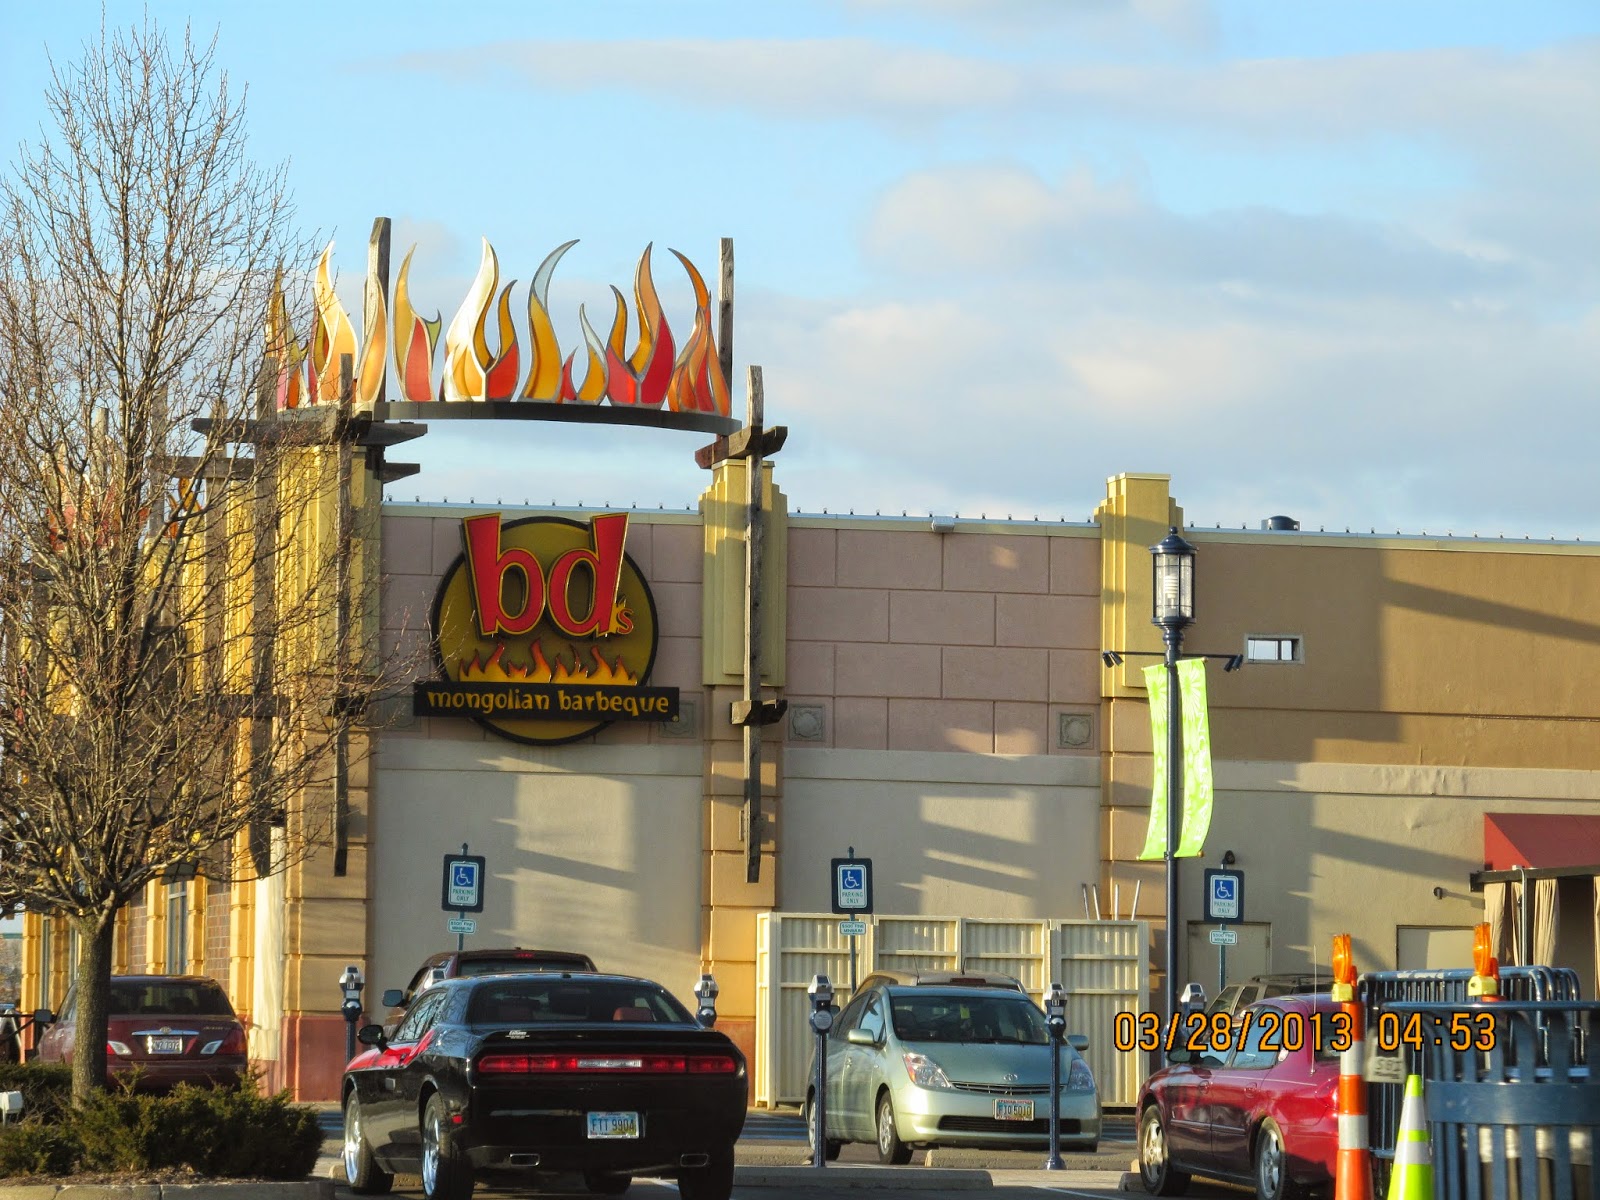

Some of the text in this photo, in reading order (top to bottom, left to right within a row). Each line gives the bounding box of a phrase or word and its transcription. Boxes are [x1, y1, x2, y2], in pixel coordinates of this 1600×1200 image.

[427, 688, 669, 717] mongolian barbeque
[453, 888, 474, 896] PARKING
